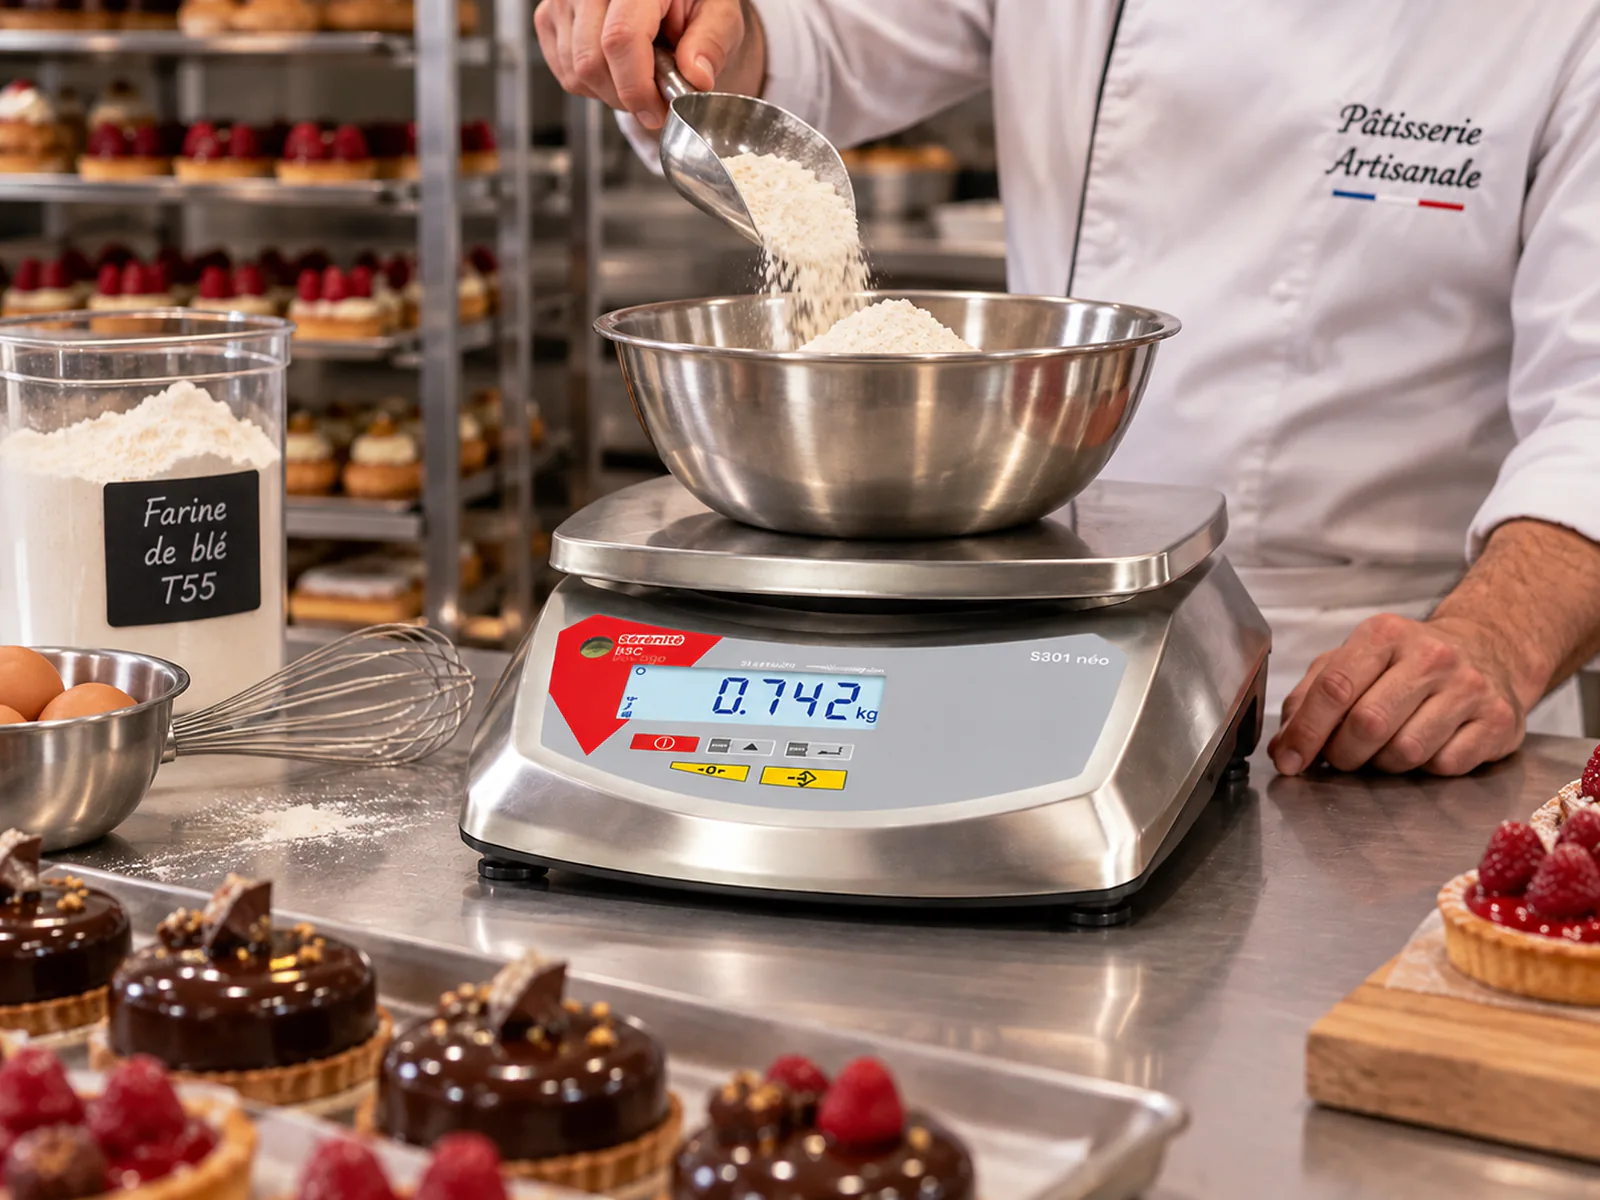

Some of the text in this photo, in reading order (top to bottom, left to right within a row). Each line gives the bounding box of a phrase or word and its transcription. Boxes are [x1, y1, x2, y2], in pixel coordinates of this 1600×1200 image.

[1337, 103, 1482, 146] Pâtisserie
[1325, 146, 1481, 189] Artisanale
[143, 496, 228, 527] Farine
[144, 531, 228, 566] de blé
[161, 571, 217, 604] T55
[1030, 651, 1110, 666] S301 néo
[712, 677, 879, 723] 0.742 kg
